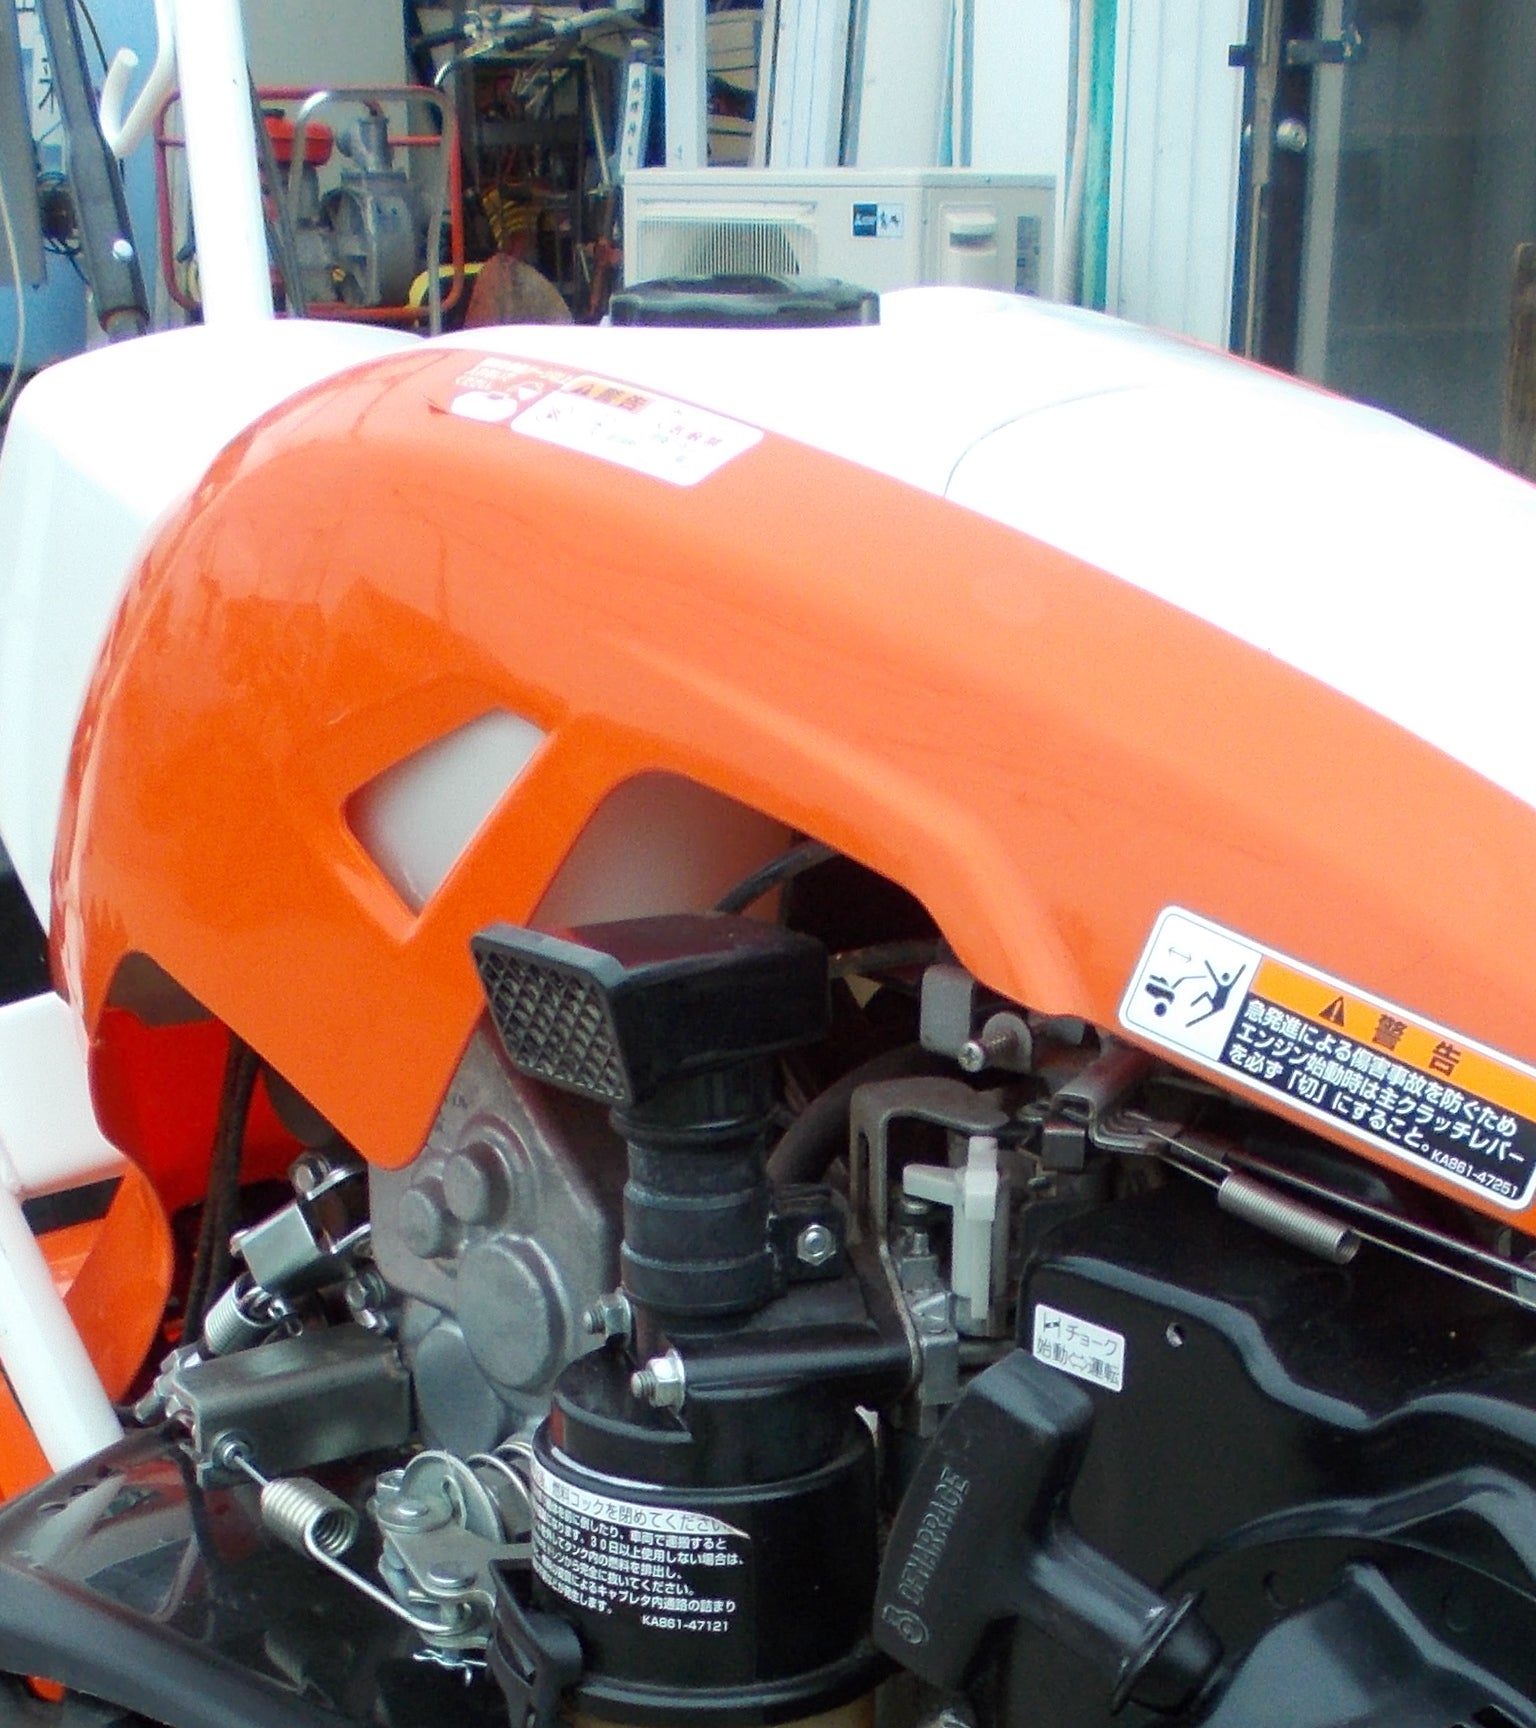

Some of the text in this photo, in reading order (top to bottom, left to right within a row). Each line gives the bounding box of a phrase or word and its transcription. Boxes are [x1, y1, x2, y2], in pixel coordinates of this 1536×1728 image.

[1227, 1046, 1431, 1153] を必ず「切」にすること。
[1235, 1022, 1526, 1164] エンジン始動時は主クラッチレバー
[1243, 999, 1518, 1138] 急発進による傷害事故を防ぐため
[1065, 1324, 1119, 1356] チョーク
[641, 1614, 730, 1633] KA861-47121
